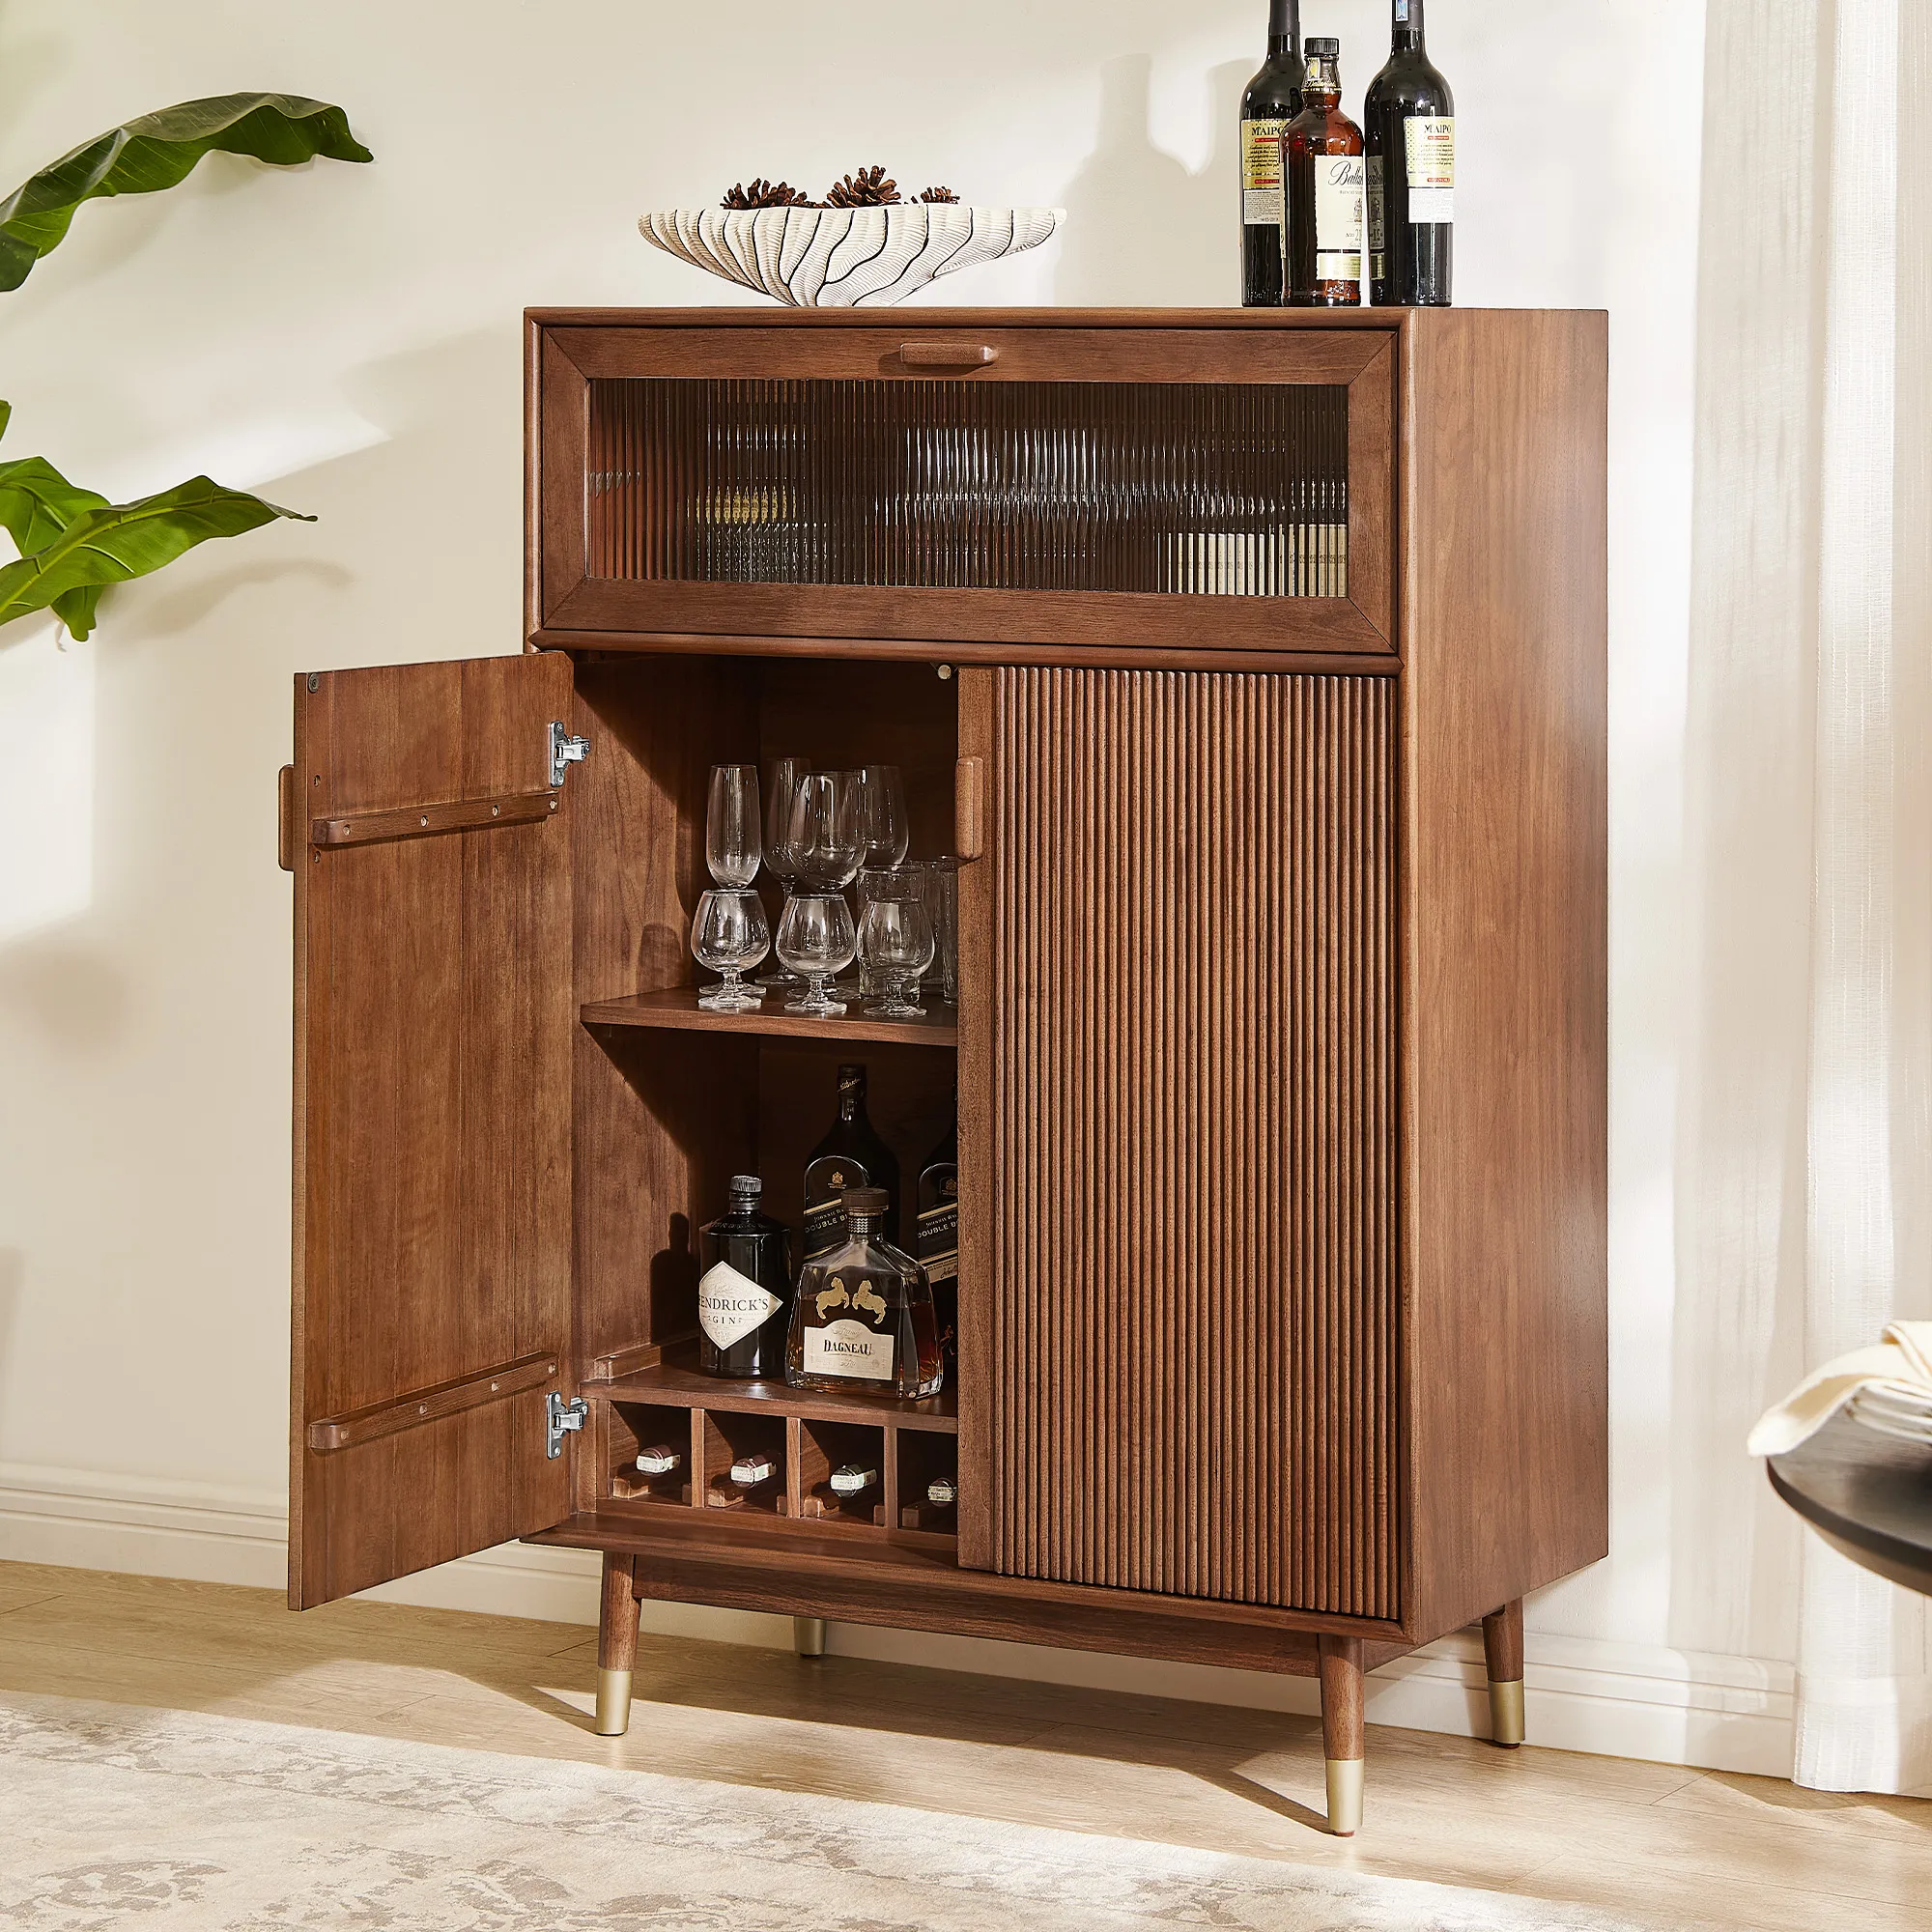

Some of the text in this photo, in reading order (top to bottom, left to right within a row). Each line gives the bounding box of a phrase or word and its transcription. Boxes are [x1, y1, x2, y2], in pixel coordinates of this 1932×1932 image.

[1424, 124, 1452, 133] MAIPO
[804, 1216, 838, 1234] DOUBLE
[917, 1223, 950, 1239] DOUBLE
[713, 1315, 736, 1324] GIN
[824, 1339, 873, 1356] DAGNEAU
